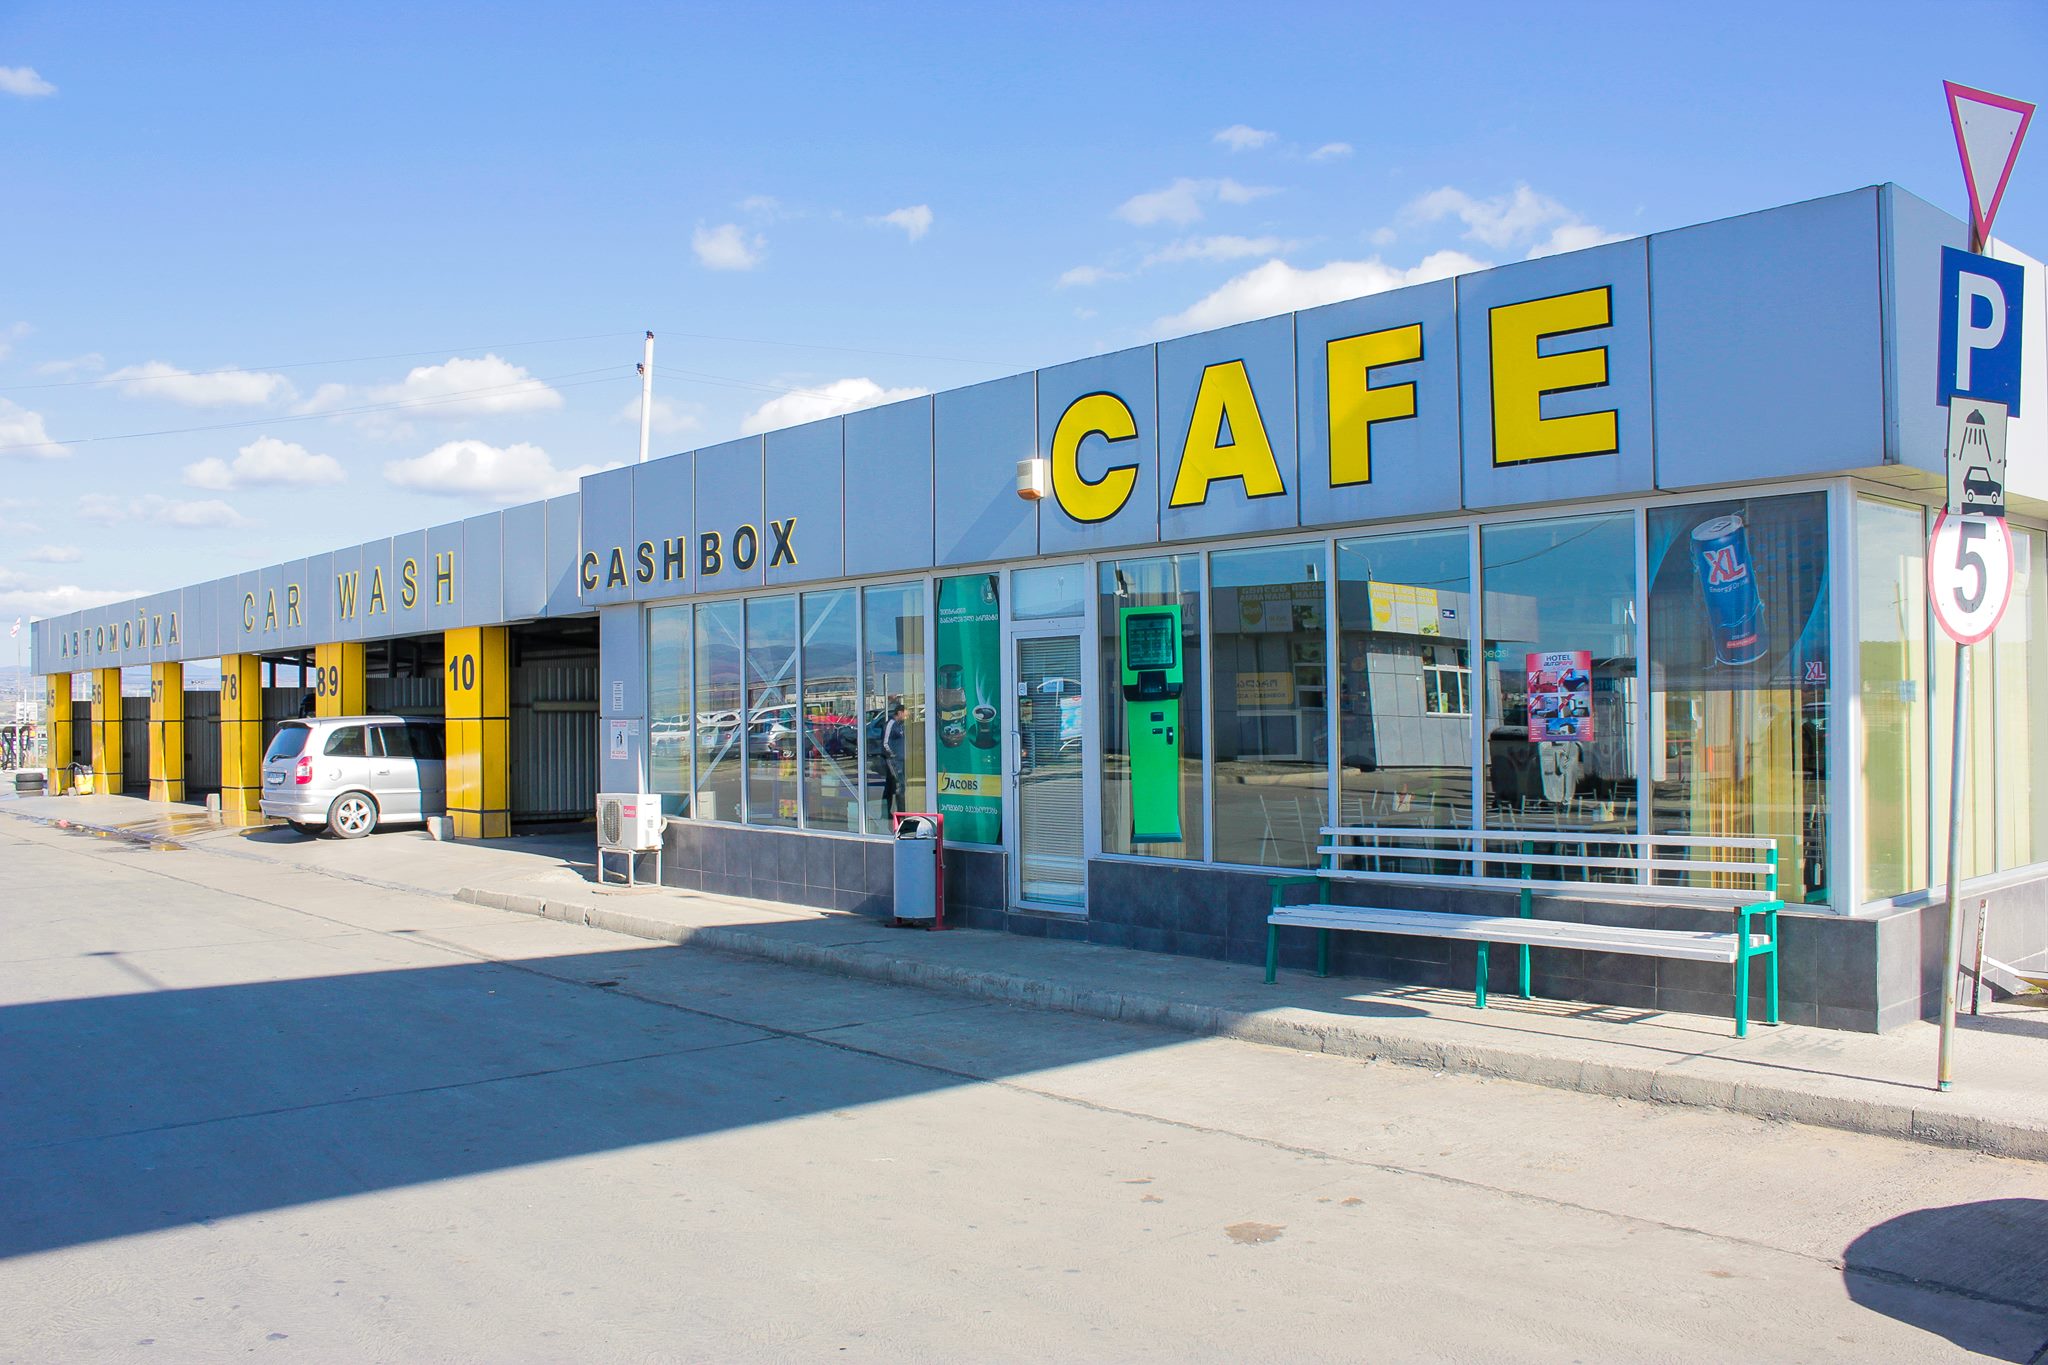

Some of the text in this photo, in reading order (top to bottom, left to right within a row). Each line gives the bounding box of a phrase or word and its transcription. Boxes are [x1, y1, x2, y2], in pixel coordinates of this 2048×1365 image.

[1956, 270, 2007, 391] P
[1050, 284, 1620, 522] CAFE
[582, 517, 798, 590] CASHBOX
[1704, 545, 1747, 584] XL
[1953, 521, 1987, 613] 5
[243, 551, 454, 633] CAR WASH
[62, 608, 179, 660] АВТОМОЙКА
[316, 665, 339, 698] 89
[448, 653, 474, 691] 10
[1805, 662, 1826, 680] XL
